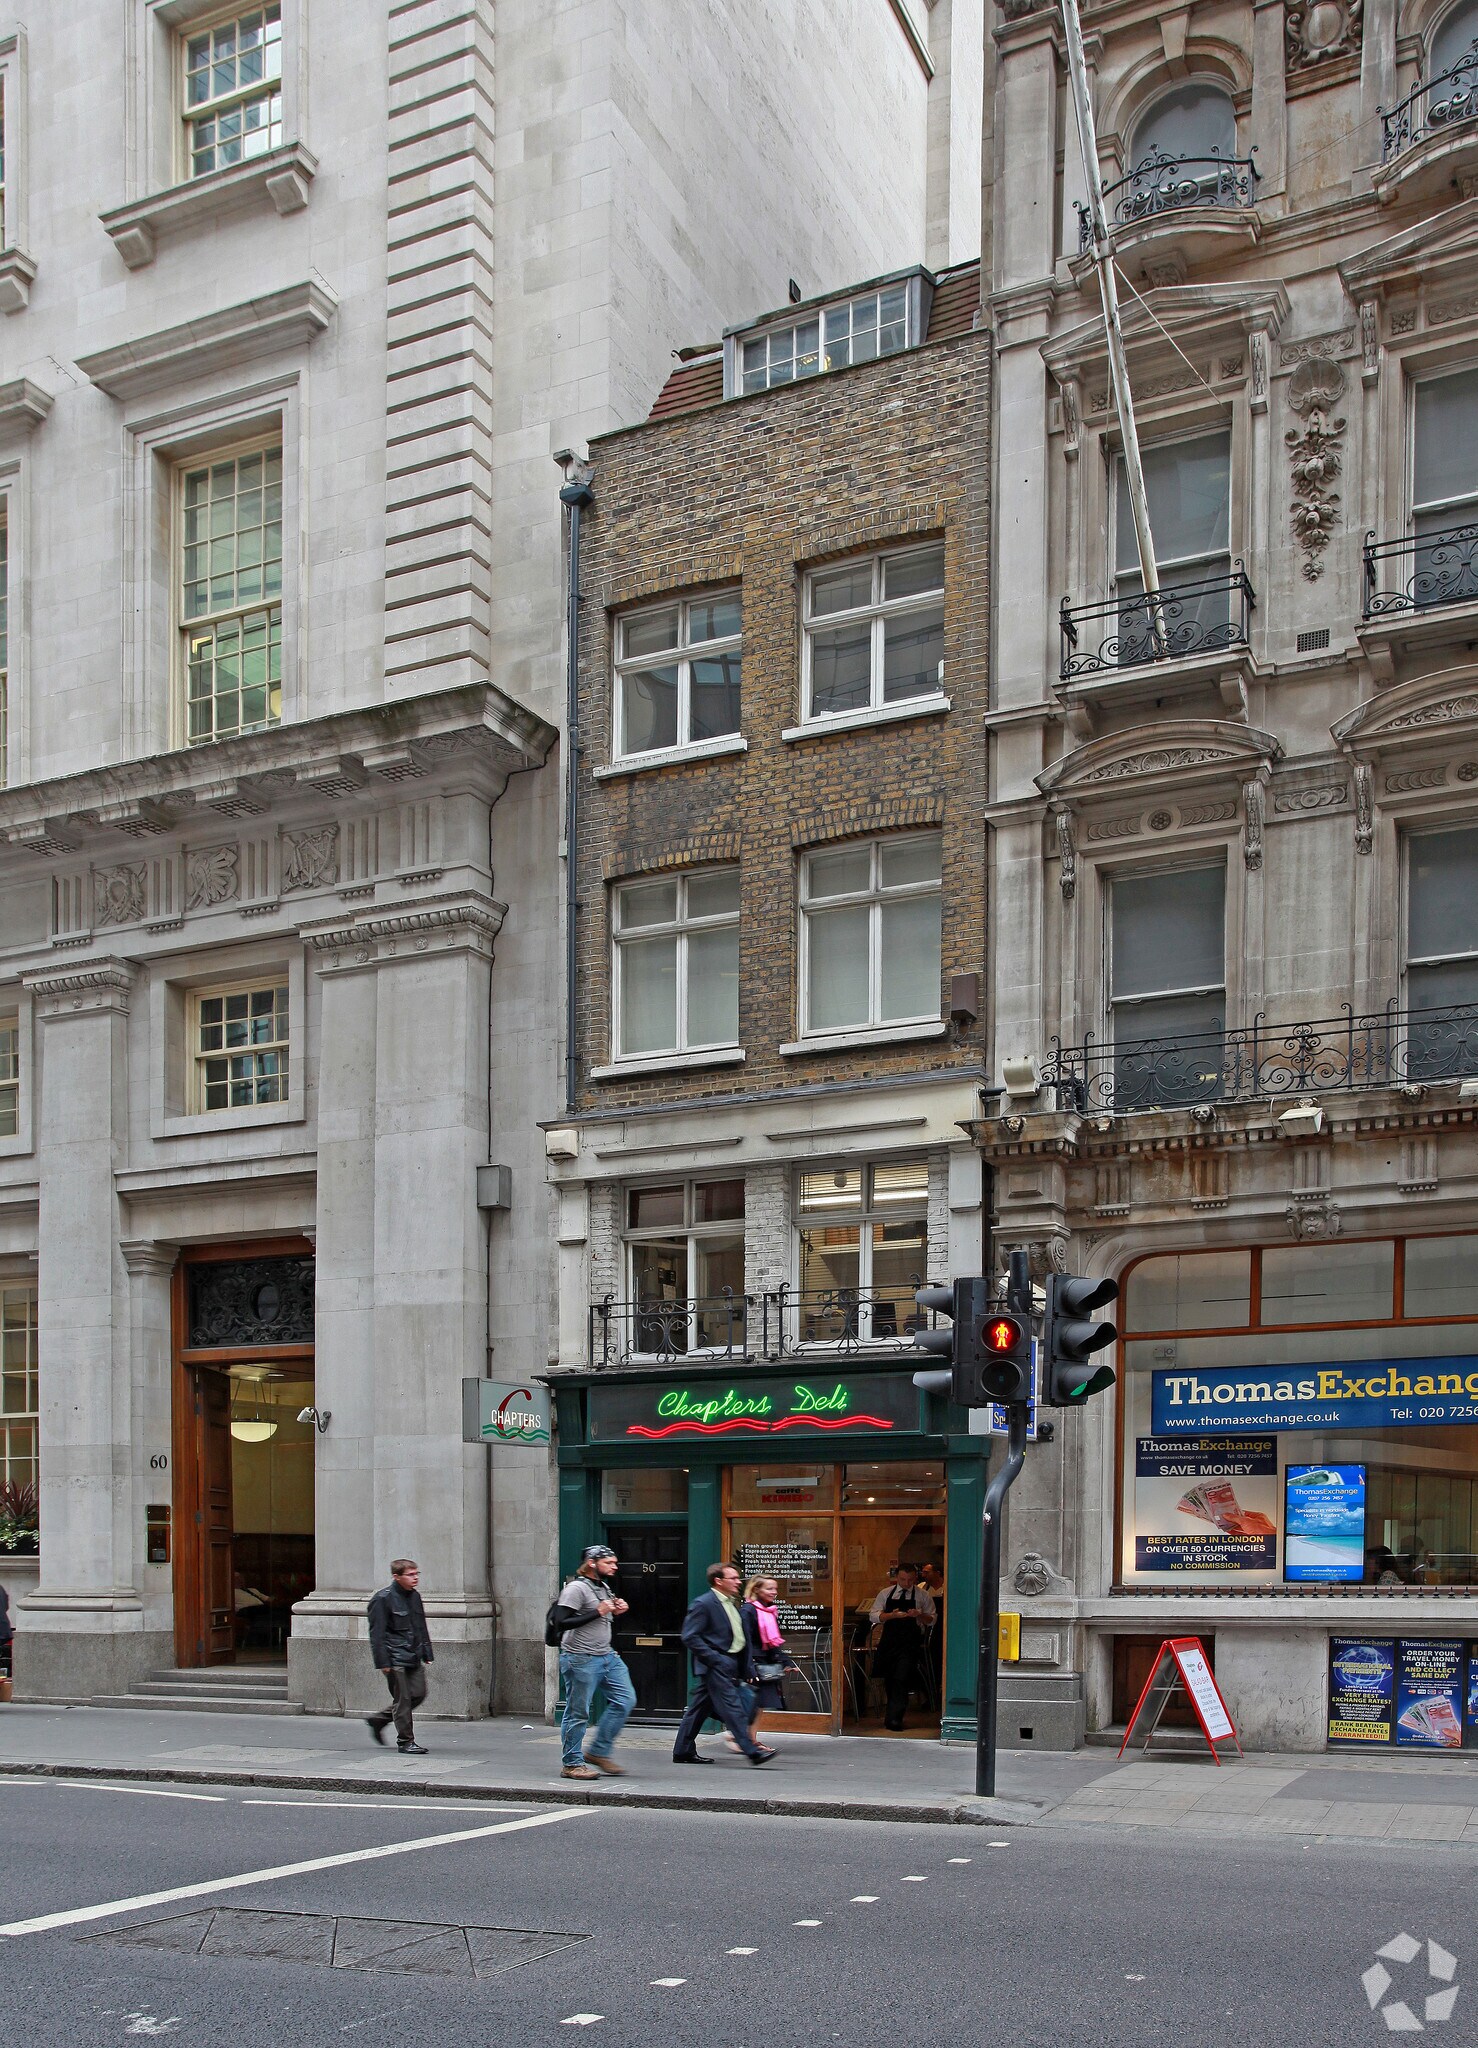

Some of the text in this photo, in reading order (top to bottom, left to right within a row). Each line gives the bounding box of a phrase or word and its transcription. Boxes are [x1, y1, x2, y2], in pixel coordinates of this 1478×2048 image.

[658, 1384, 848, 1422] Chapters Deli
[491, 1409, 541, 1428] CHAPTERS
[1165, 1411, 1340, 1427] www.thomasexchange.co.uk
[1390, 1408, 1412, 1419] Tel:
[1419, 1407, 1444, 1418] 020
[1140, 1439, 1272, 1453] ThomasExchange
[150, 1454, 168, 1469] 60
[1160, 1464, 1253, 1476] SAVE MONEY
[1294, 1488, 1358, 1496] ThomasExchange
[761, 1494, 815, 1503] KIMBO
[1175, 1536, 1207, 1544] RATES
[1222, 1535, 1264, 1543] LONDON
[1163, 1545, 1189, 1553] OVER
[1203, 1544, 1266, 1552] CURRENCIES
[1195, 1554, 1228, 1562] STOCK
[642, 1563, 656, 1573] 50
[1185, 1562, 1240, 1570] COMMISSION
[1333, 1661, 1393, 1670] INTERNATIONAL
